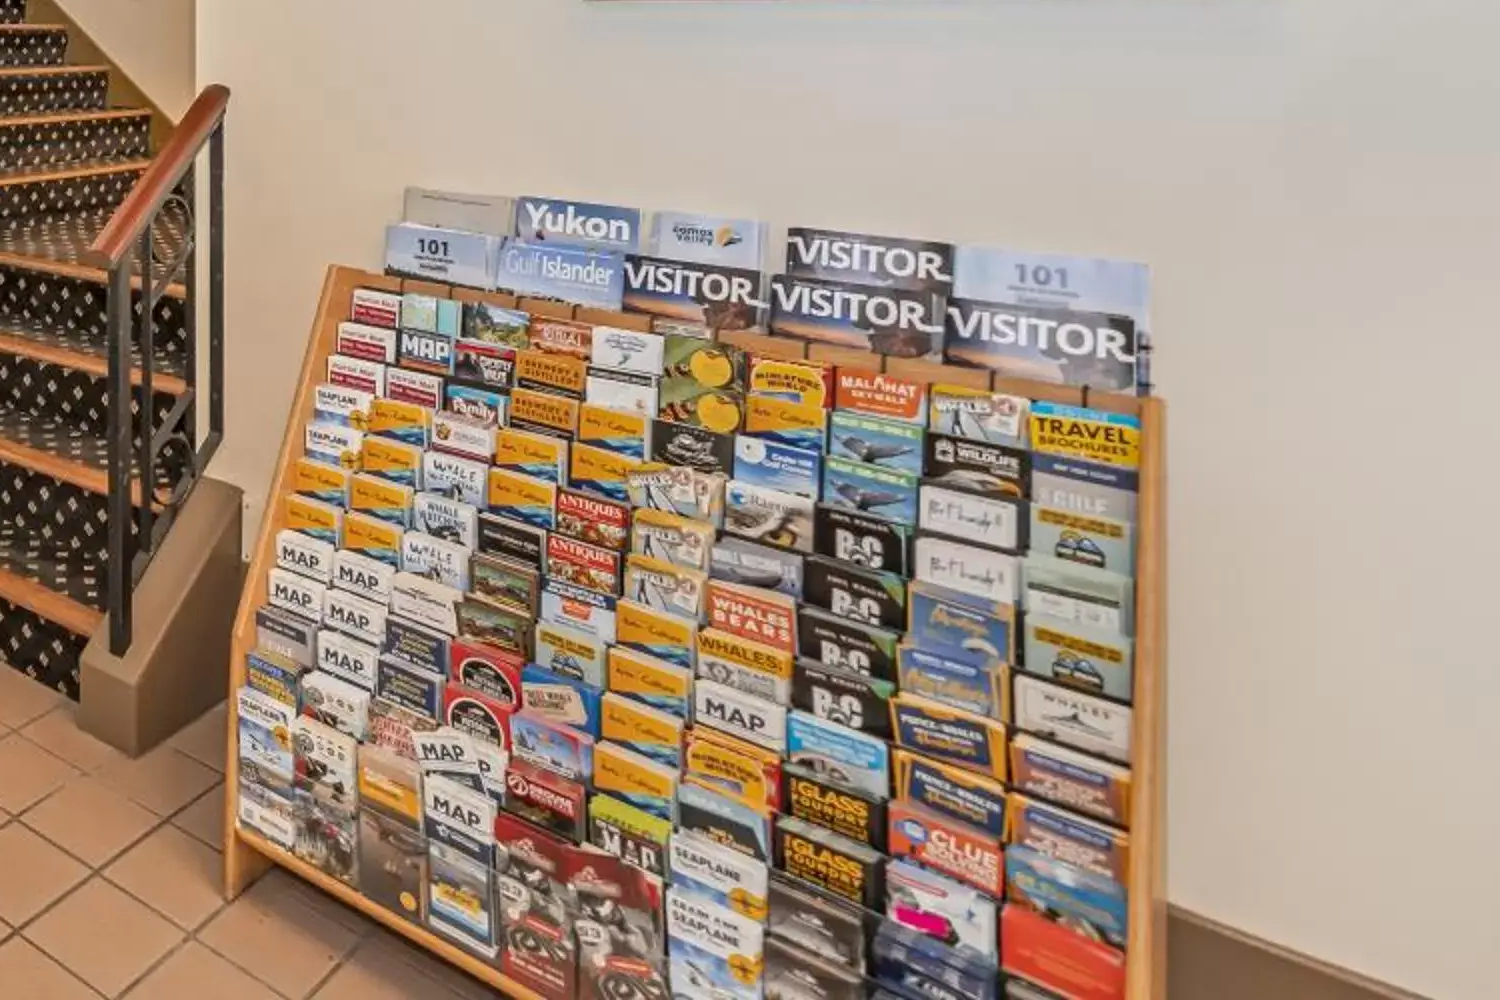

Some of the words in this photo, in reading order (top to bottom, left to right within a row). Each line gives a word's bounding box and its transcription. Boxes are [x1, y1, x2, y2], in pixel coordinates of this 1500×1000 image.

[525, 202, 629, 242] Yukon
[417, 238, 450, 256] 101
[789, 236, 952, 282] VISITOR
[505, 249, 541, 276] Gulf
[541, 254, 615, 286] Islander
[1014, 262, 1069, 289] 101
[625, 260, 768, 310] VISITOR
[772, 282, 944, 334] VISITOR
[948, 305, 1136, 363] VISITOR
[452, 396, 497, 423] Family
[1036, 416, 1131, 446] TRAVEL
[1038, 435, 1130, 457] BROCHURES
[558, 492, 622, 517] ANTIQUES
[282, 545, 319, 569] MAP
[339, 565, 379, 589] MAP
[275, 583, 312, 607] MAP
[713, 595, 790, 629] WHALES
[329, 603, 370, 628] MAP
[713, 609, 791, 643] BEARS
[324, 648, 365, 674] MAP
[705, 696, 765, 732] MAP
[421, 743, 465, 762] MAP
[432, 795, 482, 827] MAP
[797, 778, 869, 815] GLASS
[675, 846, 742, 883] SEAPLANE
[792, 833, 864, 878] GLASS
[930, 829, 998, 869] CLUE
[672, 909, 740, 948] SEAPLANE
